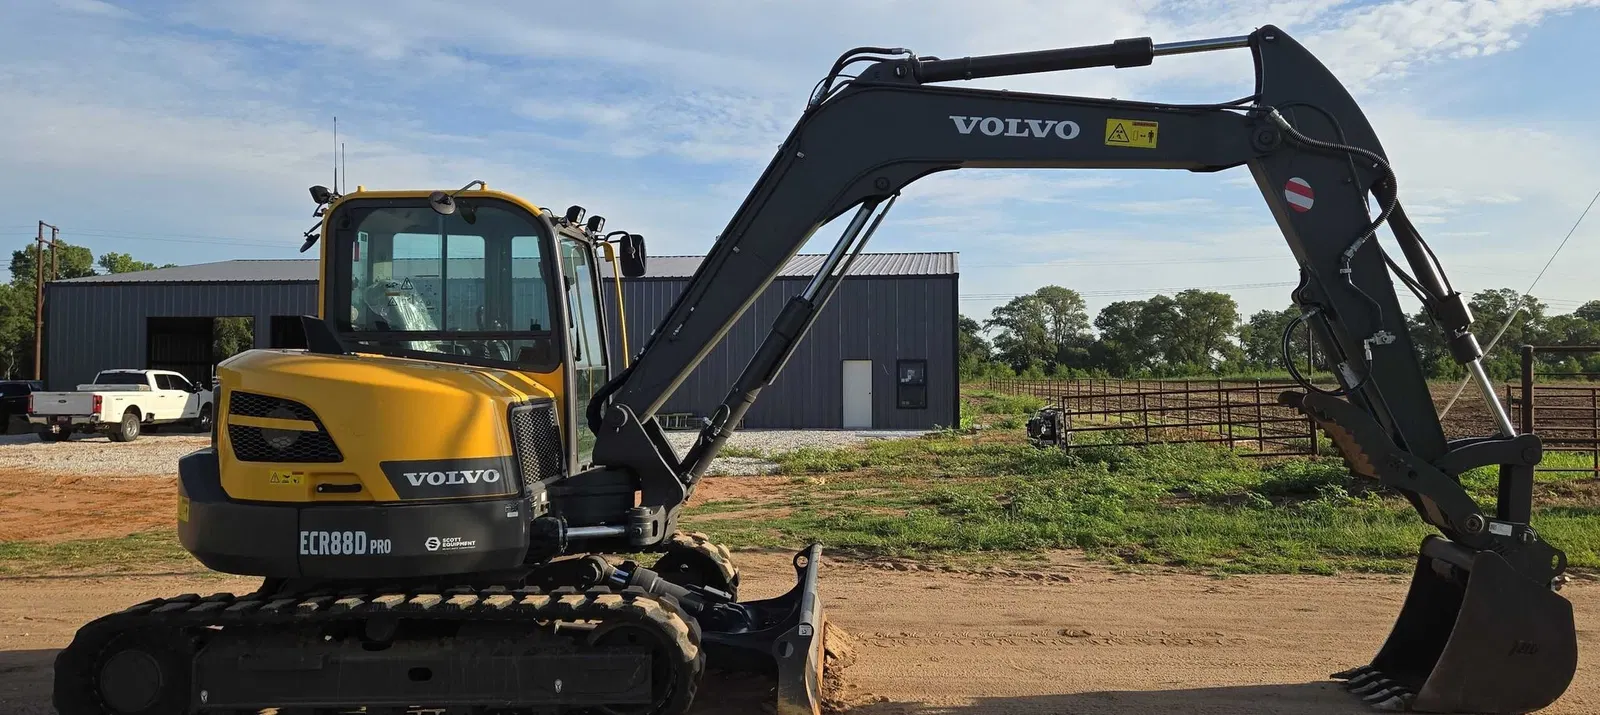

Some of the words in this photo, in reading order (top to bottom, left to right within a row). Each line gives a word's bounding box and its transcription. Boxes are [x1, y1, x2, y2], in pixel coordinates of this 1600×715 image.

[949, 115, 1080, 140] VOLVO
[403, 469, 500, 487] VOLVO
[300, 531, 367, 555] ECR88D
[370, 539, 392, 554] PRO
[442, 540, 476, 548] EQUIPMENT
